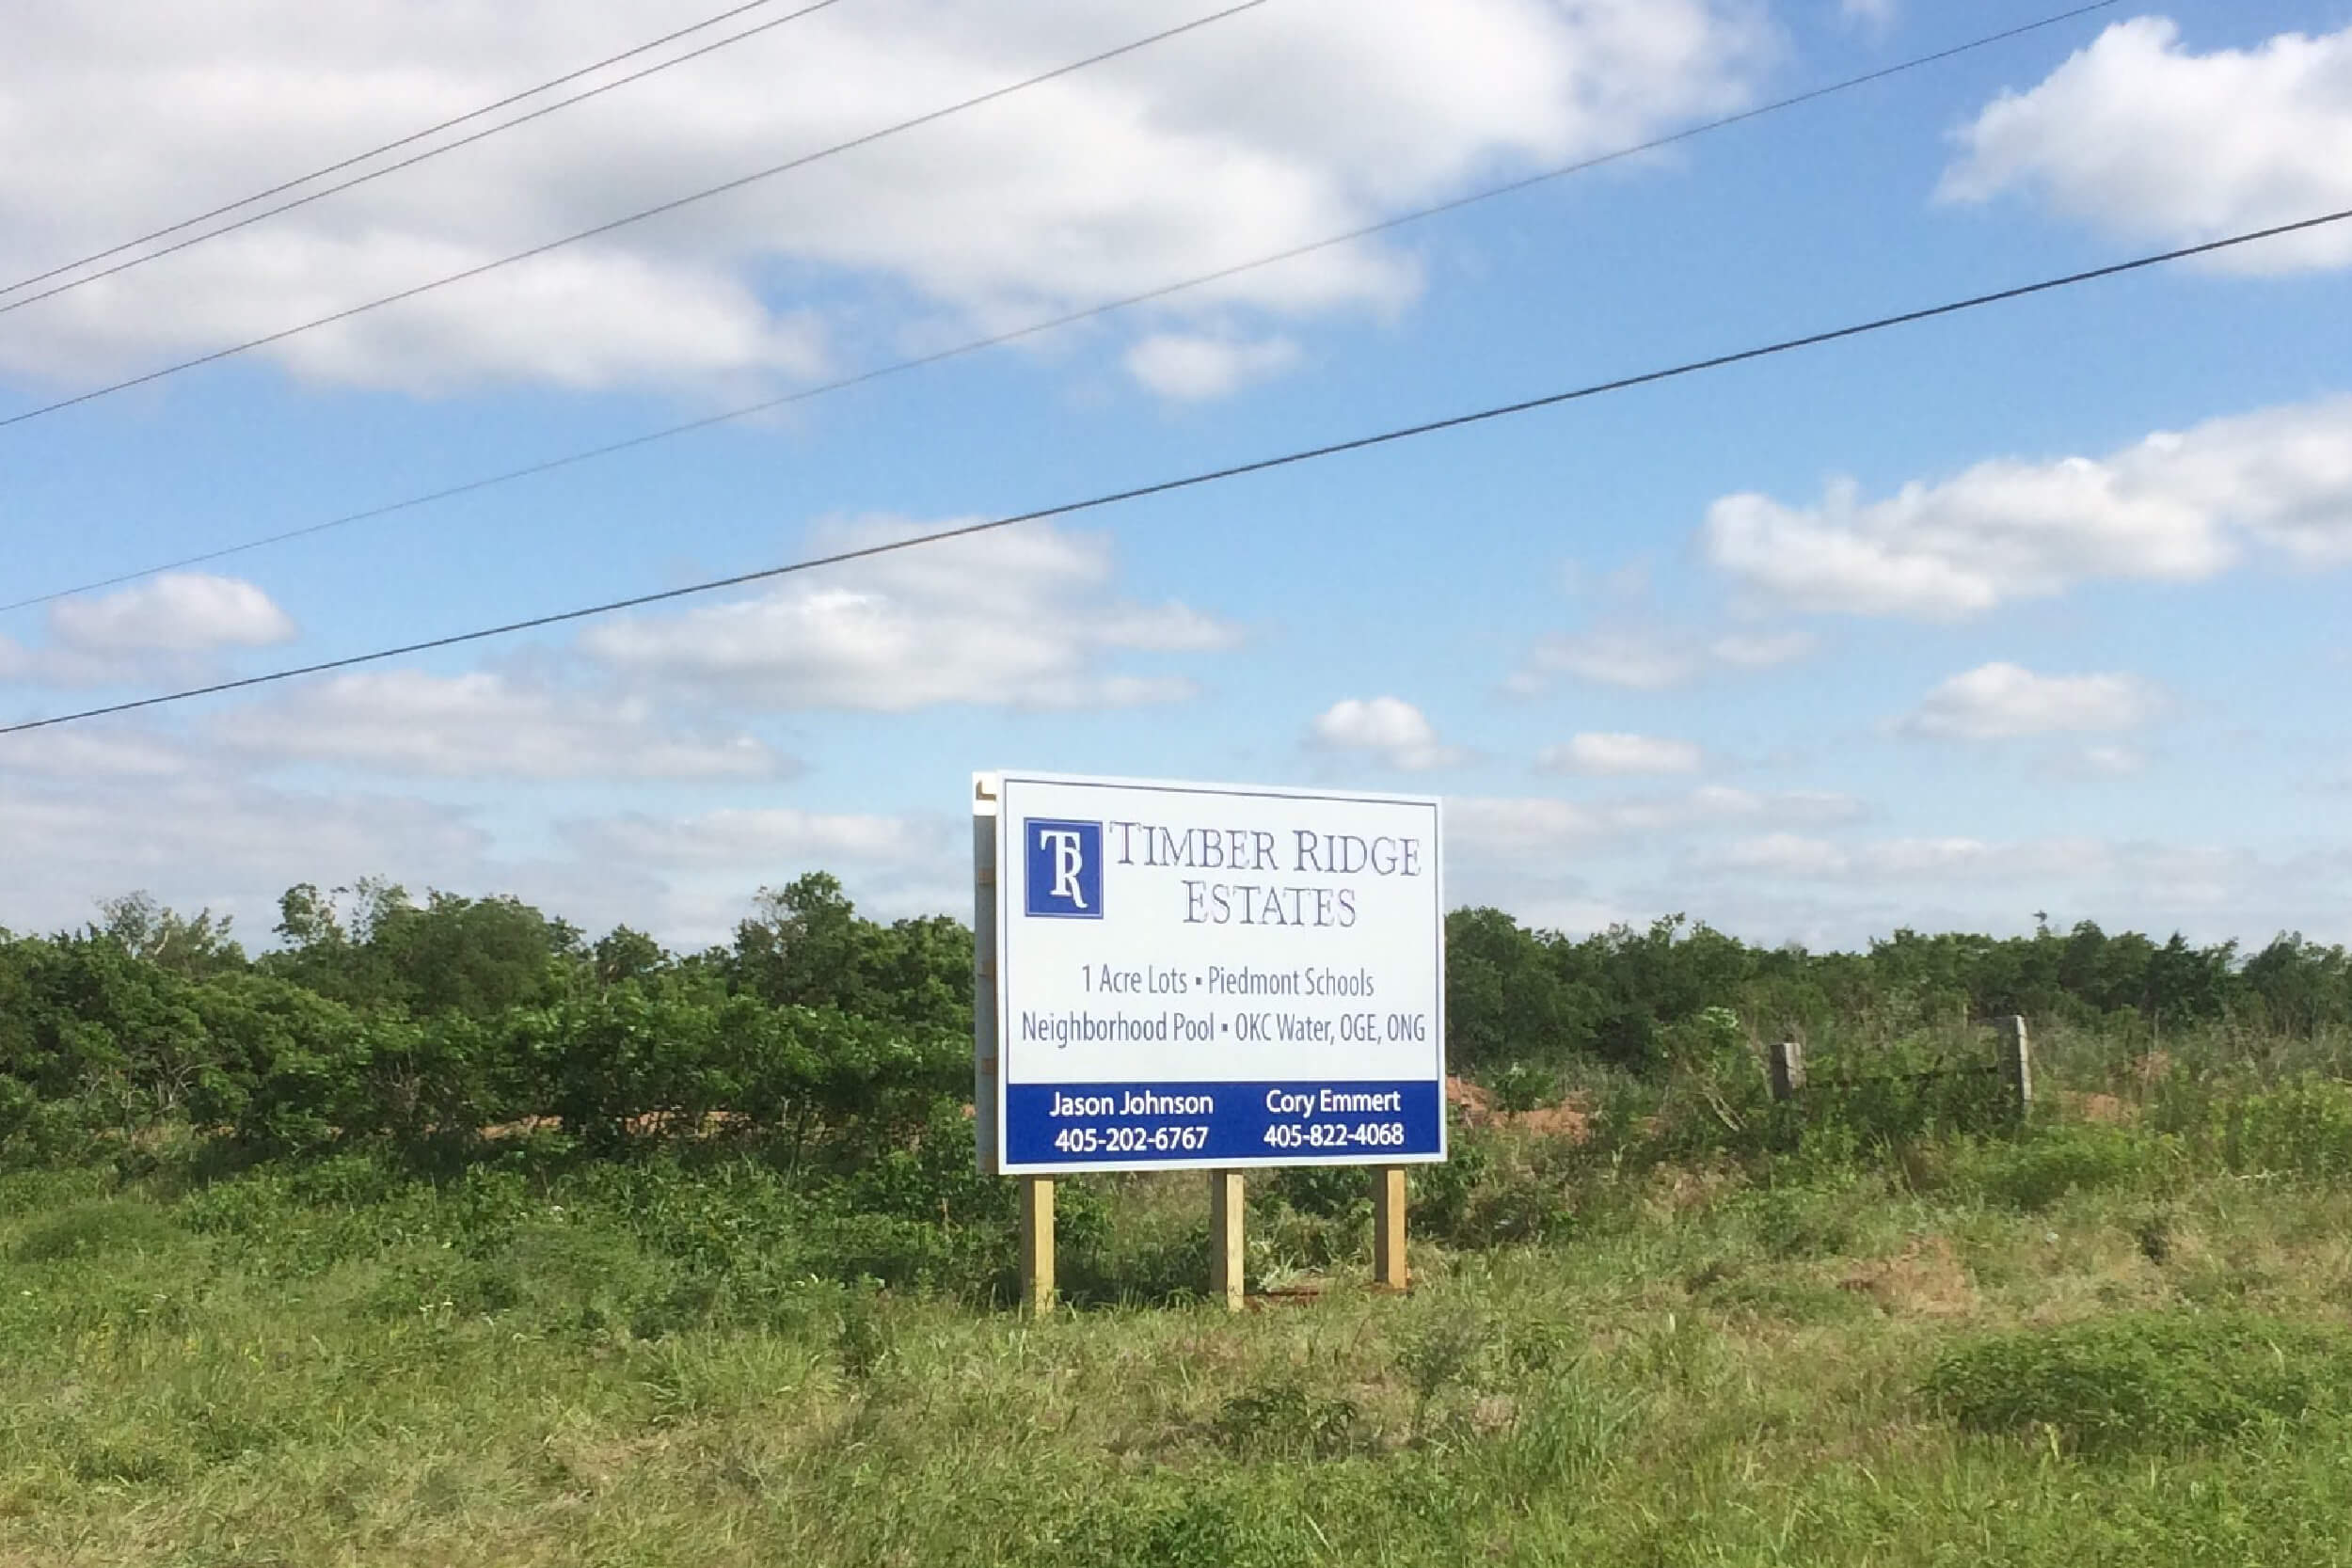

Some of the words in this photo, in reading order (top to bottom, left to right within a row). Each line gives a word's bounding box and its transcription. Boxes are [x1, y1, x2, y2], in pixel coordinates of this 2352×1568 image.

[1109, 820, 1279, 872] TIMBER
[1293, 830, 1422, 877] RIDGE
[1182, 879, 1357, 927] ESTATES
[1082, 965, 1090, 991] 1
[1100, 964, 1142, 993] Acre
[1148, 966, 1187, 994] Lots
[1209, 966, 1300, 995] Piedmont
[1305, 967, 1374, 996] Schools
[1024, 1011, 1167, 1048] Neighborhood
[1174, 1012, 1214, 1041] Pool
[1235, 1013, 1272, 1041] OKC
[1277, 1013, 1334, 1044] Water,
[1341, 1014, 1381, 1044] OGE,
[1387, 1014, 1424, 1042] ONG
[1050, 1092, 1114, 1117] Jason
[1120, 1091, 1213, 1115] Johnson
[1266, 1090, 1314, 1117] Cory
[1320, 1090, 1401, 1112] Emmert
[1055, 1127, 1208, 1151] 405-202-6767
[1263, 1123, 1404, 1147] 405-822-4068
